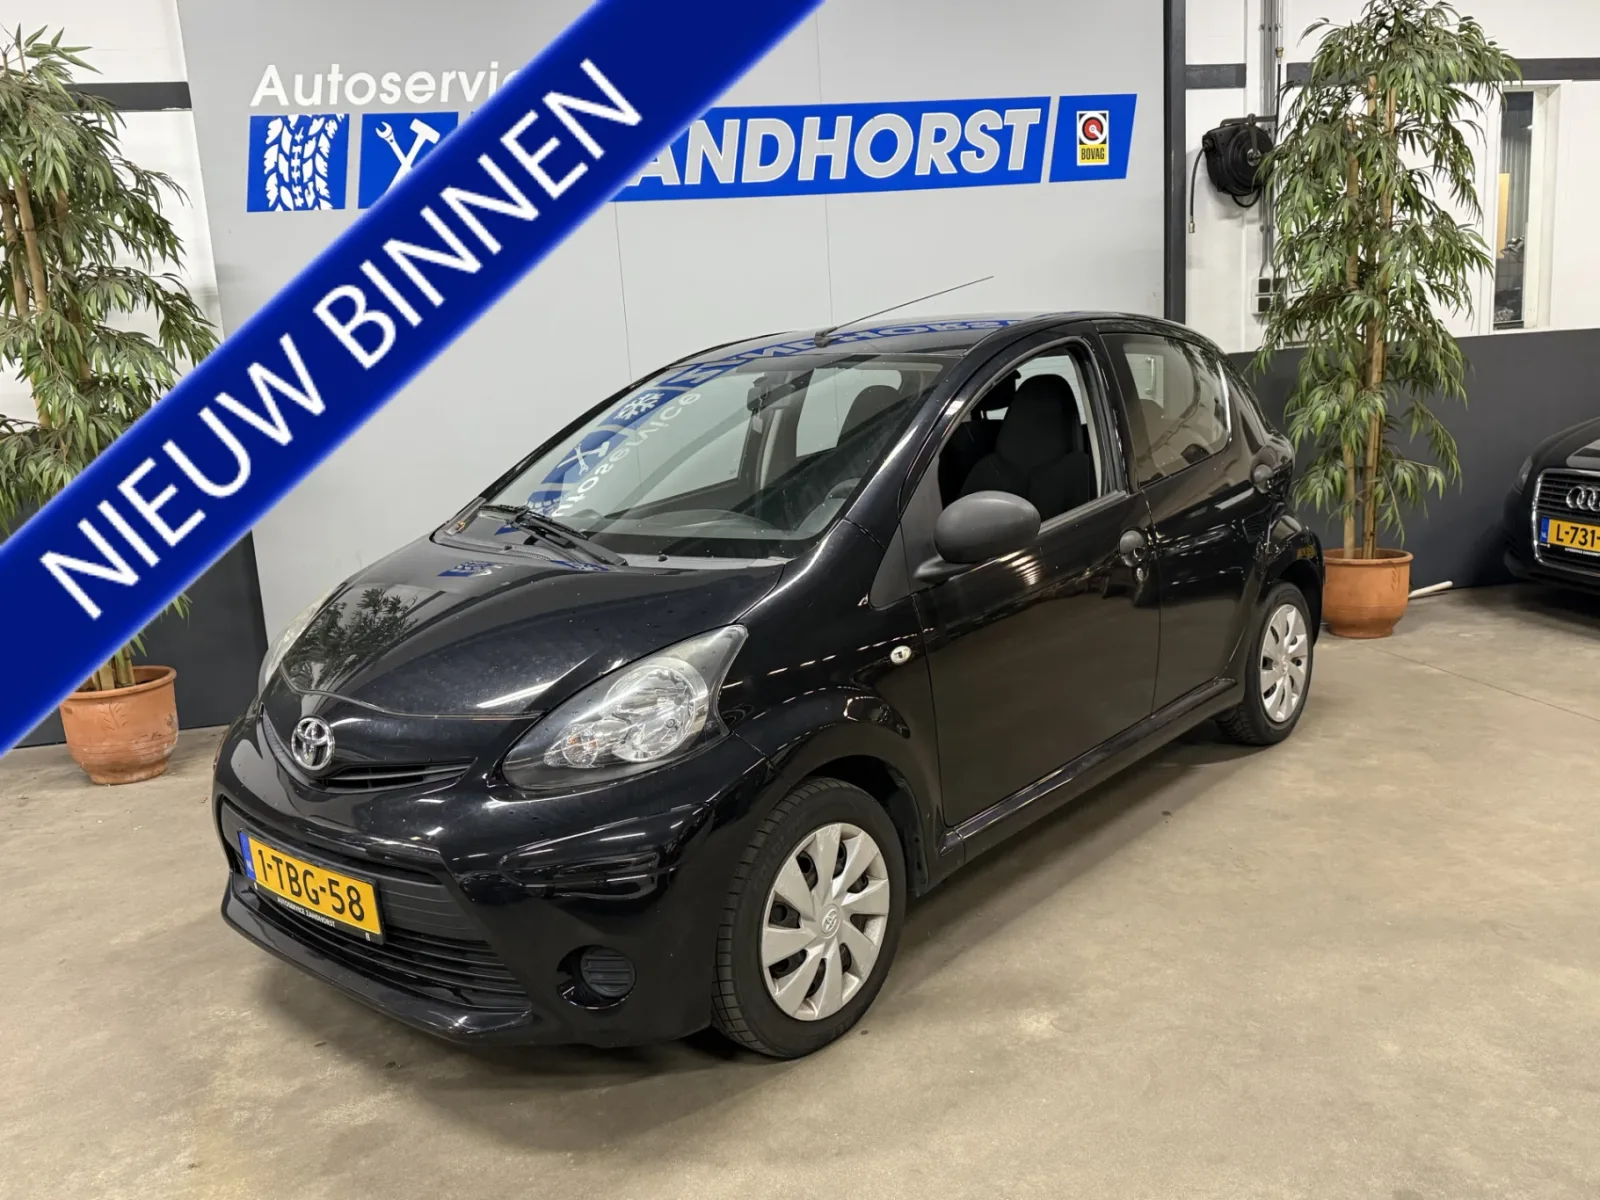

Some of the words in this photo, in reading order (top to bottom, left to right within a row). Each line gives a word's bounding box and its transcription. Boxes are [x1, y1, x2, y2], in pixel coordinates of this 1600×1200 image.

[250, 61, 519, 107] Autoservi
[626, 108, 1042, 187] ANDHORST
[1081, 147, 1105, 160] BOVAG
[258, 849, 365, 922] 1-TBG-58
